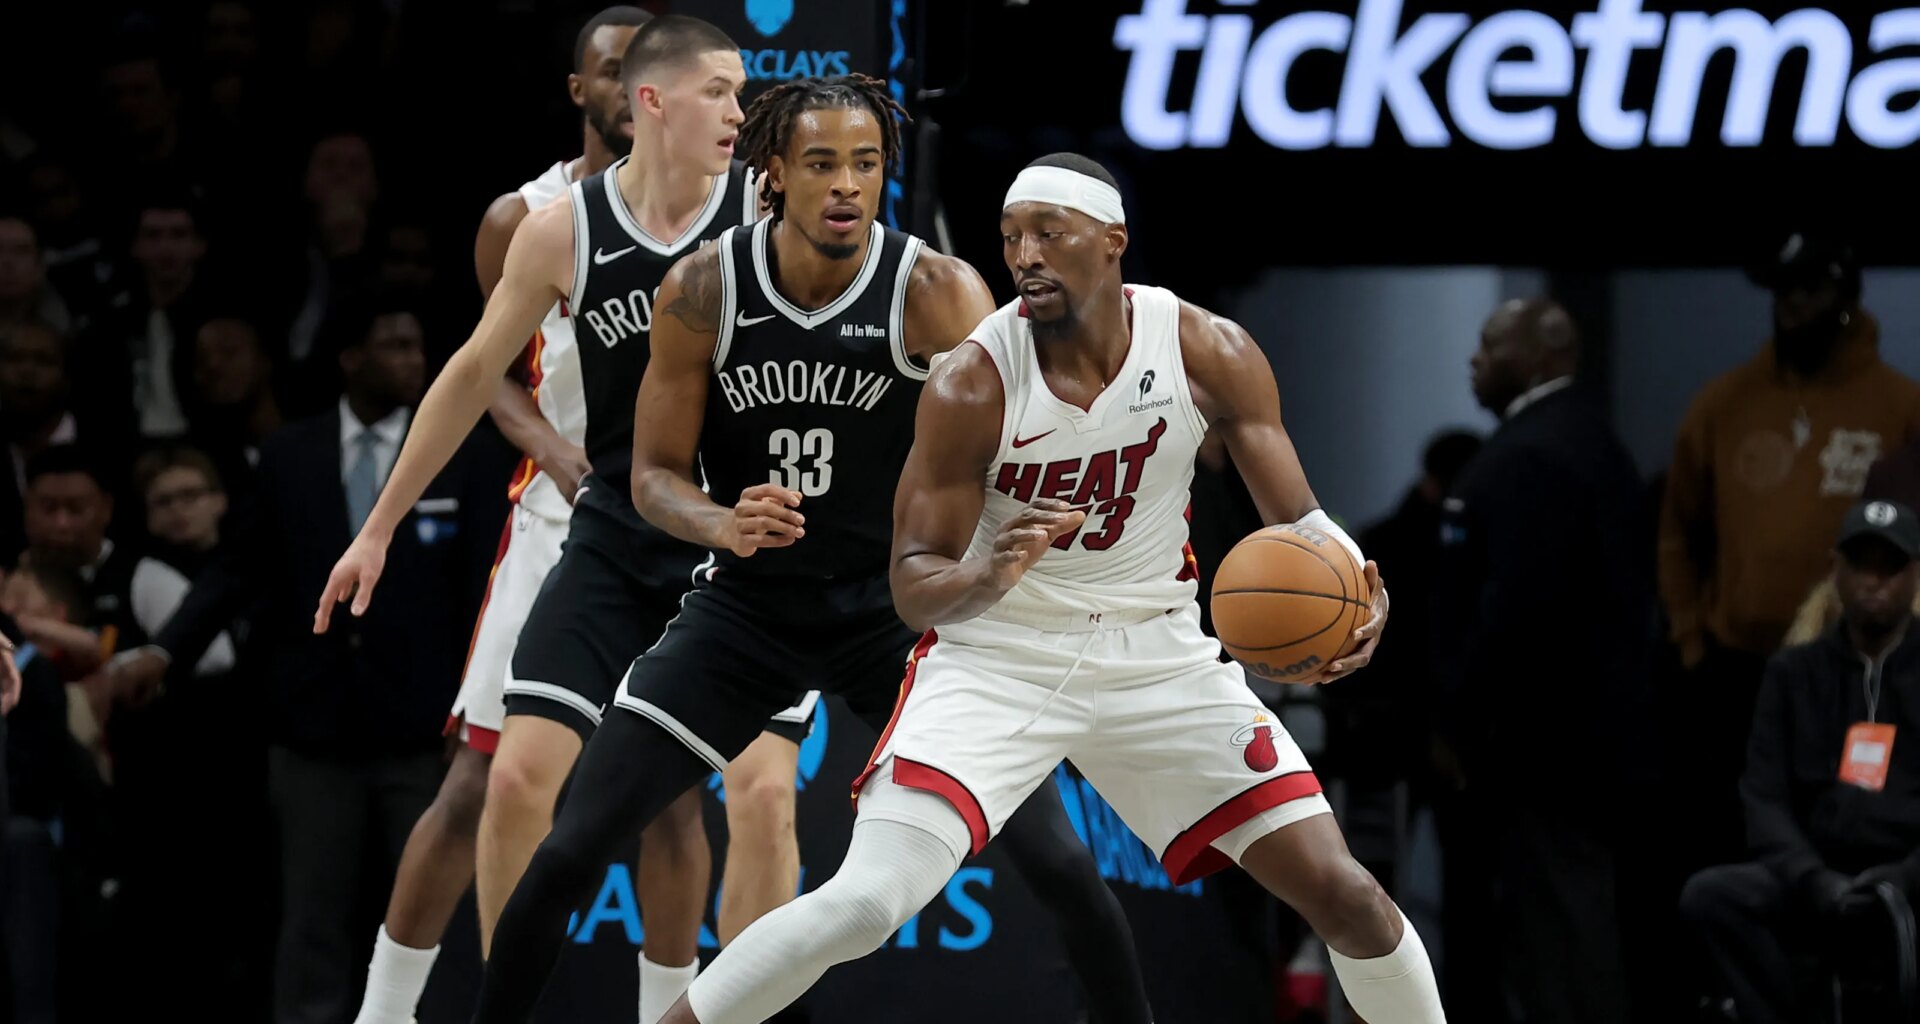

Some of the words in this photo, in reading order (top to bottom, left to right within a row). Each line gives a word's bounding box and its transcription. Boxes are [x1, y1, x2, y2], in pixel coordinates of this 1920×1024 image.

[1113, 0, 1920, 150] ticketma
[584, 285, 660, 349] BRO
[840, 323, 853, 337] All
[855, 324, 864, 337] In
[865, 324, 885, 338] Won
[718, 360, 894, 413] BROOKLYN
[1129, 396, 1173, 414] Robinhood
[768, 428, 834, 497] 33
[994, 416, 1167, 504] HEAT
[1243, 655, 1321, 677] ilson
